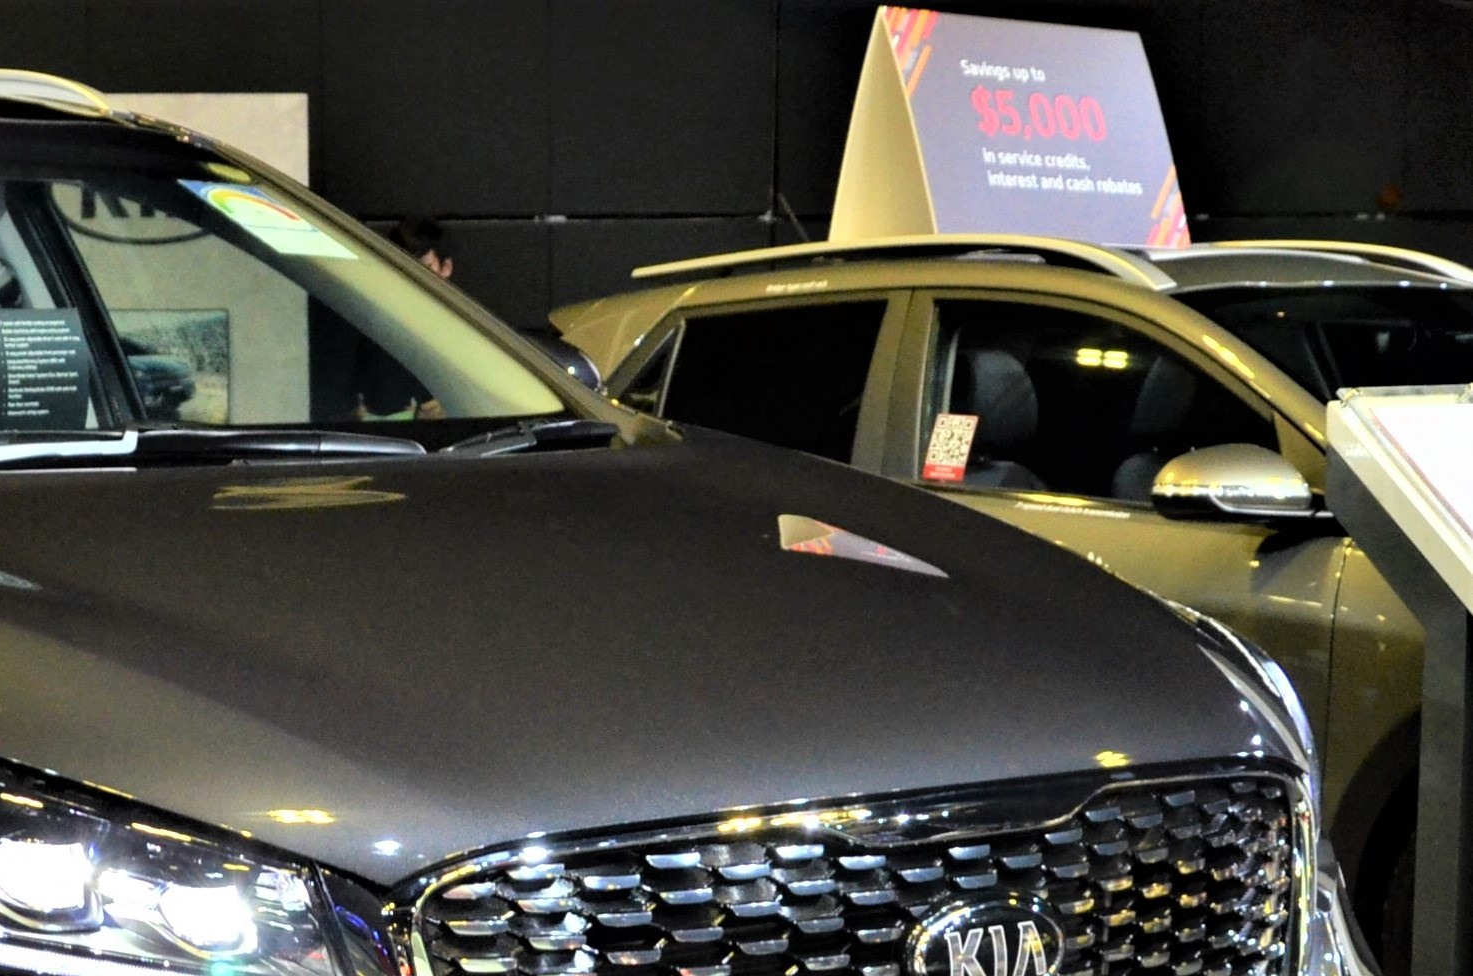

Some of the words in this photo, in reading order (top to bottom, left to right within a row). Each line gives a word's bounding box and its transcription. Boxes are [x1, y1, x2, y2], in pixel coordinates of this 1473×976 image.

[960, 59, 1011, 82] Savings
[1013, 68, 1029, 83] up
[1030, 66, 1046, 82] to
[970, 84, 1107, 142] $5,000
[982, 147, 996, 163] in
[998, 151, 1043, 167] service
[1045, 153, 1092, 171] credits,
[987, 170, 1038, 189] interest
[1040, 174, 1064, 190] and
[1066, 176, 1095, 192] cash
[1096, 178, 1144, 196] rebates
